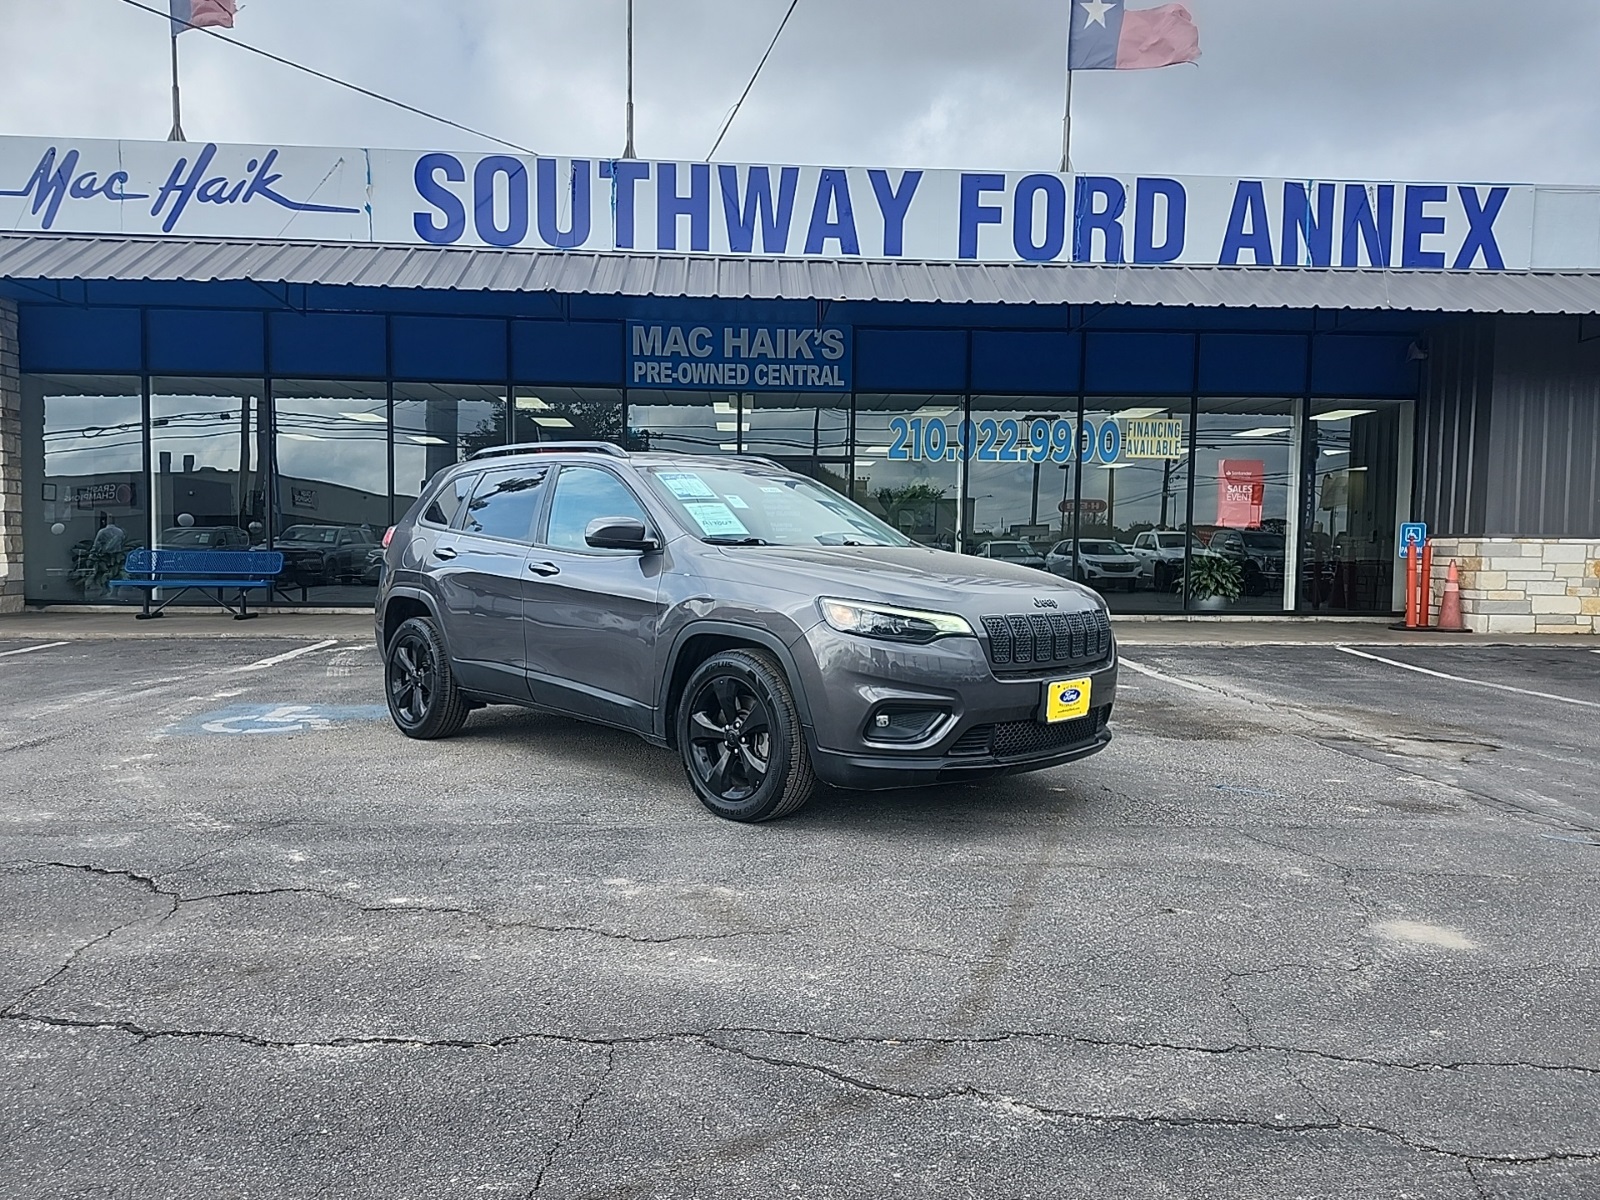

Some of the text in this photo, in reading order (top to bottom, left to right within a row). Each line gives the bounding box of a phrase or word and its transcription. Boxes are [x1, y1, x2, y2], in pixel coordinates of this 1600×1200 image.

[1, 142, 362, 232] Mac Haik
[413, 151, 1511, 271] SOUTHWAY FORD ANNEX
[632, 325, 845, 360] MAC HAIK'S
[633, 361, 845, 386] PRE-OWNED CENTRAL
[1127, 421, 1181, 438] FINANCING
[887, 416, 1122, 464] 210.922.9900
[1127, 439, 1180, 456] AVAILABLE
[1226, 493, 1252, 501] EVENT
[1227, 484, 1253, 493] SALES
[1033, 597, 1058, 609] Jeep
[1063, 690, 1078, 701] Ford
